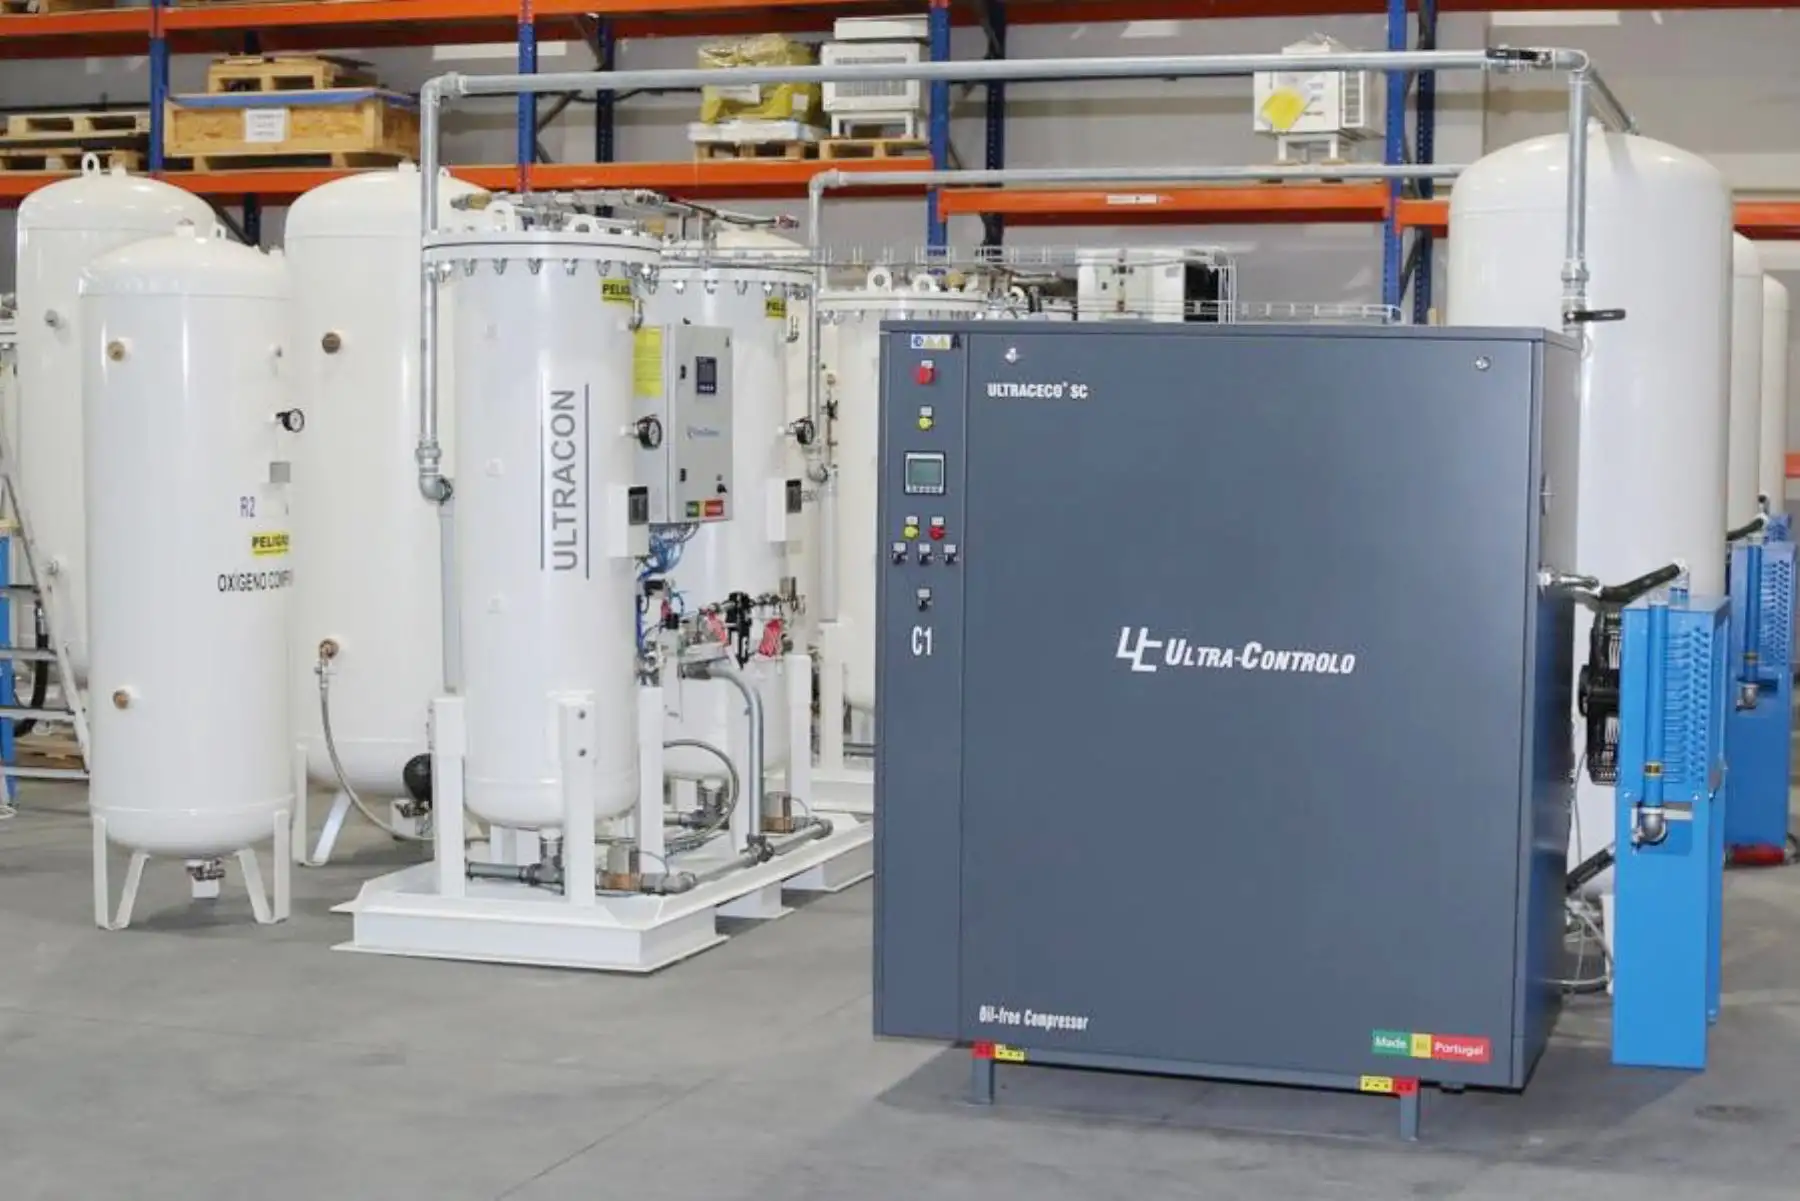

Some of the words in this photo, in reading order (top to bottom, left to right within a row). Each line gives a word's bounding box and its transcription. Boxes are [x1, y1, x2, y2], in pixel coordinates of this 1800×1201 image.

[1069, 383, 1089, 399] SC
[550, 389, 578, 571] ULTRACON
[911, 625, 933, 656] C1
[979, 1004, 1021, 1026] Oil-free
[1023, 1008, 1089, 1032] Compressor
[1374, 1034, 1408, 1049] Made
[1433, 1040, 1484, 1058] Portugal
